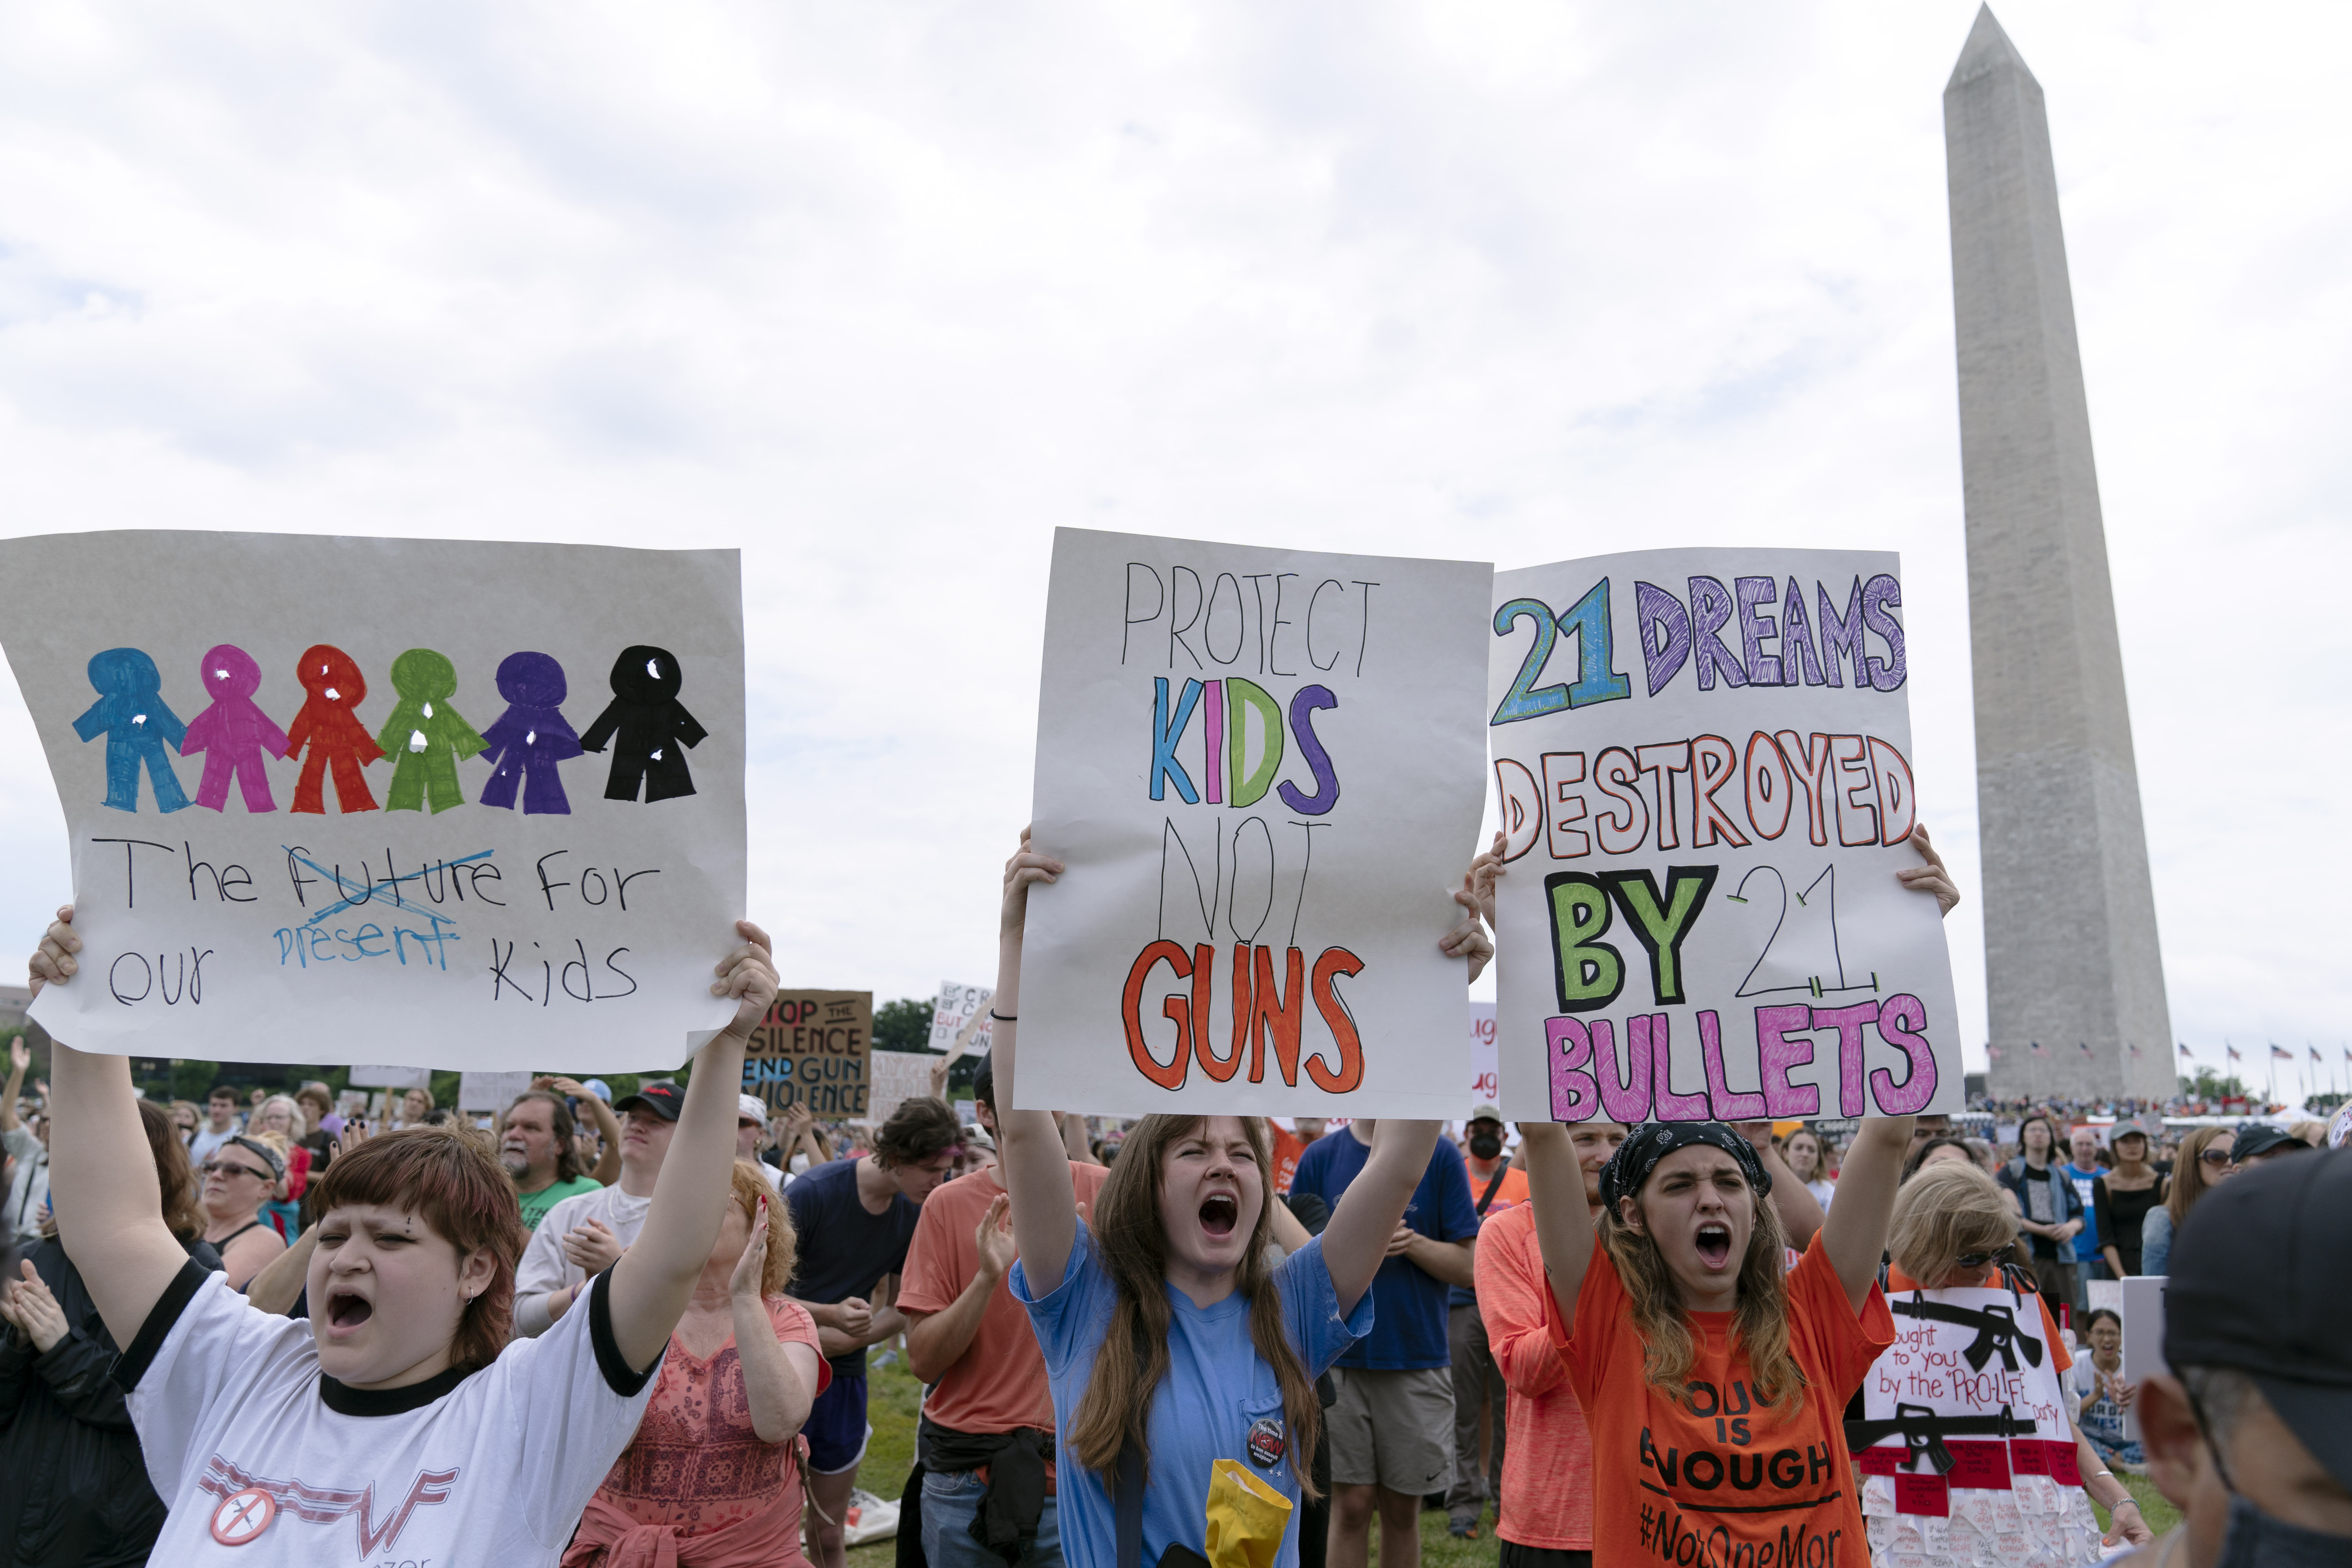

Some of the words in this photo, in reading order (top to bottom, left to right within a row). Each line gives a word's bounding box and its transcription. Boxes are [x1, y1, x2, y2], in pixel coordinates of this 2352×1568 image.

[1122, 563, 1380, 677] PROTECT
[1490, 577, 1631, 726] 21
[1635, 574, 1907, 698] DREAMS
[1149, 676, 1340, 815] KIDS
[1494, 730, 1916, 864] DESTROYED
[92, 838, 257, 909] The
[536, 849, 661, 912] For
[1158, 816, 1332, 945] NOT
[273, 916, 460, 970] present
[1544, 865, 1719, 1013] BY
[1727, 864, 1880, 998] 21
[110, 946, 213, 1006] our
[490, 938, 638, 1006] Kids
[767, 1000, 818, 1024] TOP
[828, 1006, 852, 1018] THE
[1122, 939, 1365, 1094] GUNS
[746, 1026, 862, 1056] SILENCE
[1544, 993, 1938, 1124] BULLETS
[742, 1058, 794, 1081] END
[799, 1056, 862, 1084] GUN
[1893, 1350, 1909, 1365] to
[1921, 1350, 1957, 1372] you
[1894, 1324, 1937, 1353] ought
[1880, 1368, 1901, 1404] by
[1908, 1370, 1943, 1398] the
[1250, 1429, 1284, 1455] NOW
[1258, 1423, 1267, 1432] The
[1267, 1428, 1278, 1437] time
[1715, 1418, 1751, 1446] IS
[2032, 1399, 2058, 1435] party
[1254, 1452, 1272, 1464] weapons!
[1264, 1450, 1278, 1461] assault
[1640, 1426, 1832, 1490] ENOUGH
[1640, 1503, 1841, 1568] #NotOneMor
